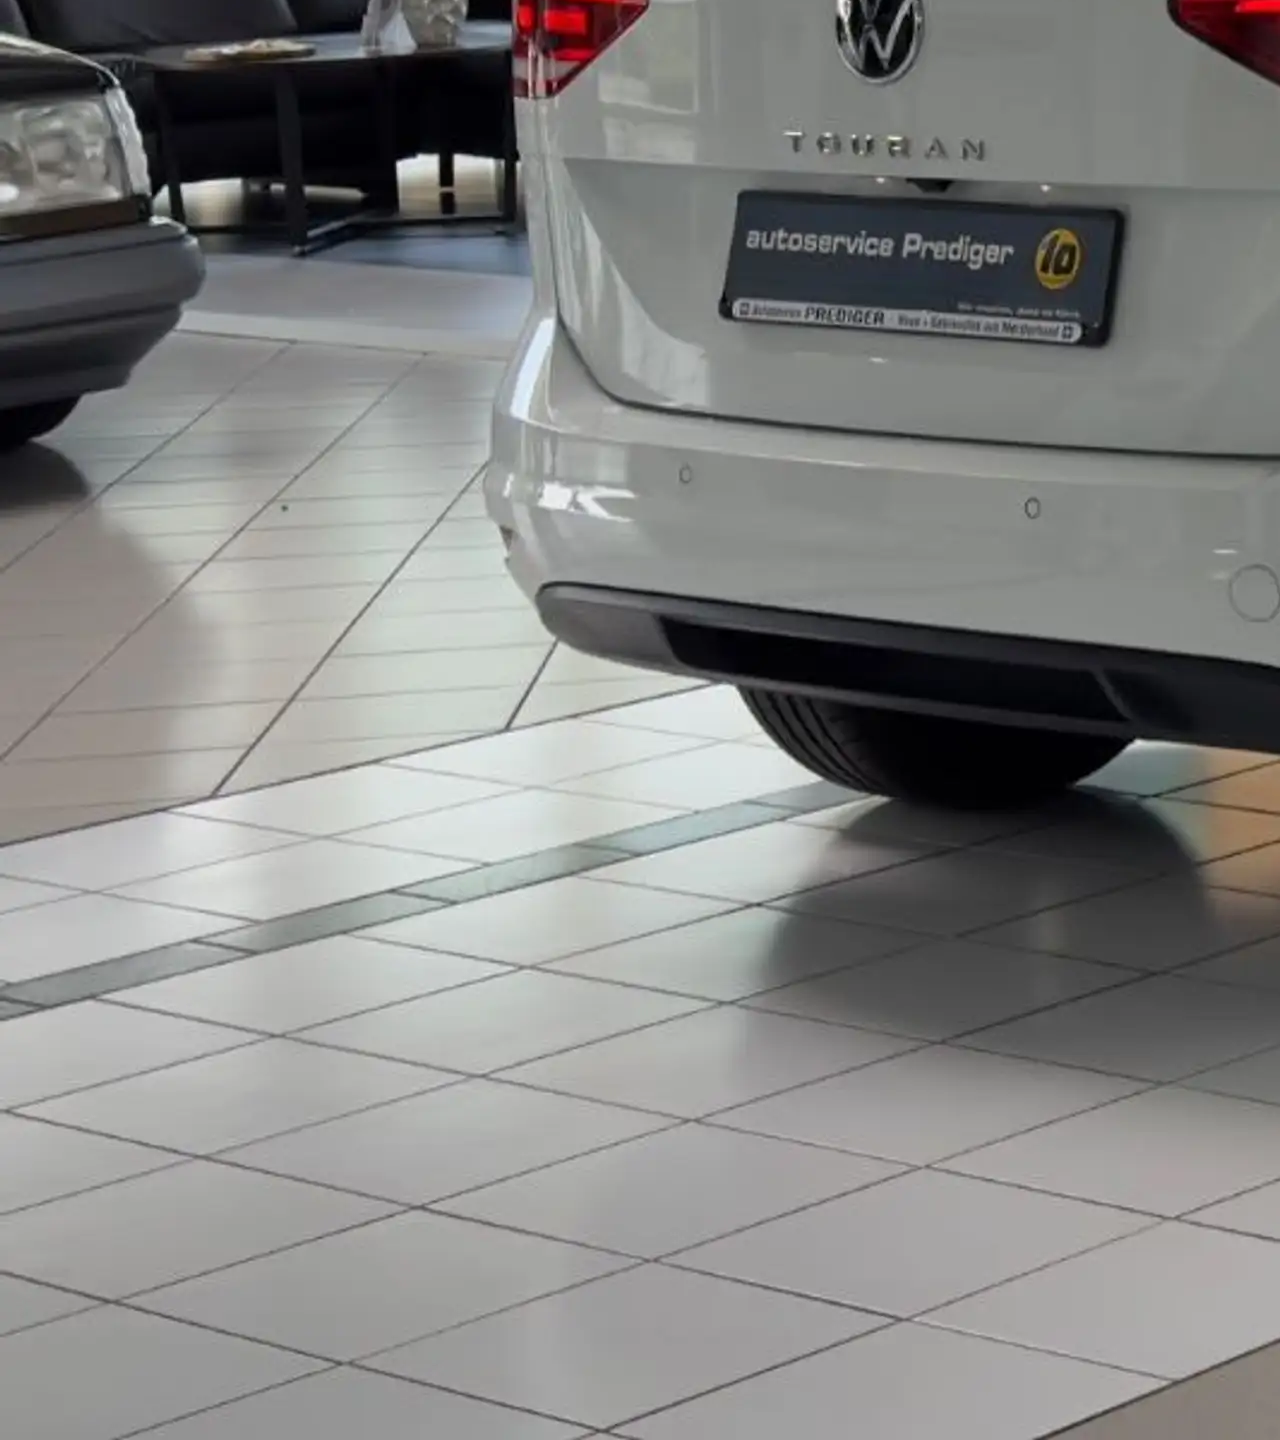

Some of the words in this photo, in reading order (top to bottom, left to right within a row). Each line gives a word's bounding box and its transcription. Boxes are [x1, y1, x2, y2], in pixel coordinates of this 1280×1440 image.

[784, 130, 987, 162] TOURAN
[746, 227, 895, 258] autoservice
[902, 233, 1014, 271] Prediger
[804, 305, 885, 326] PREDIGER
